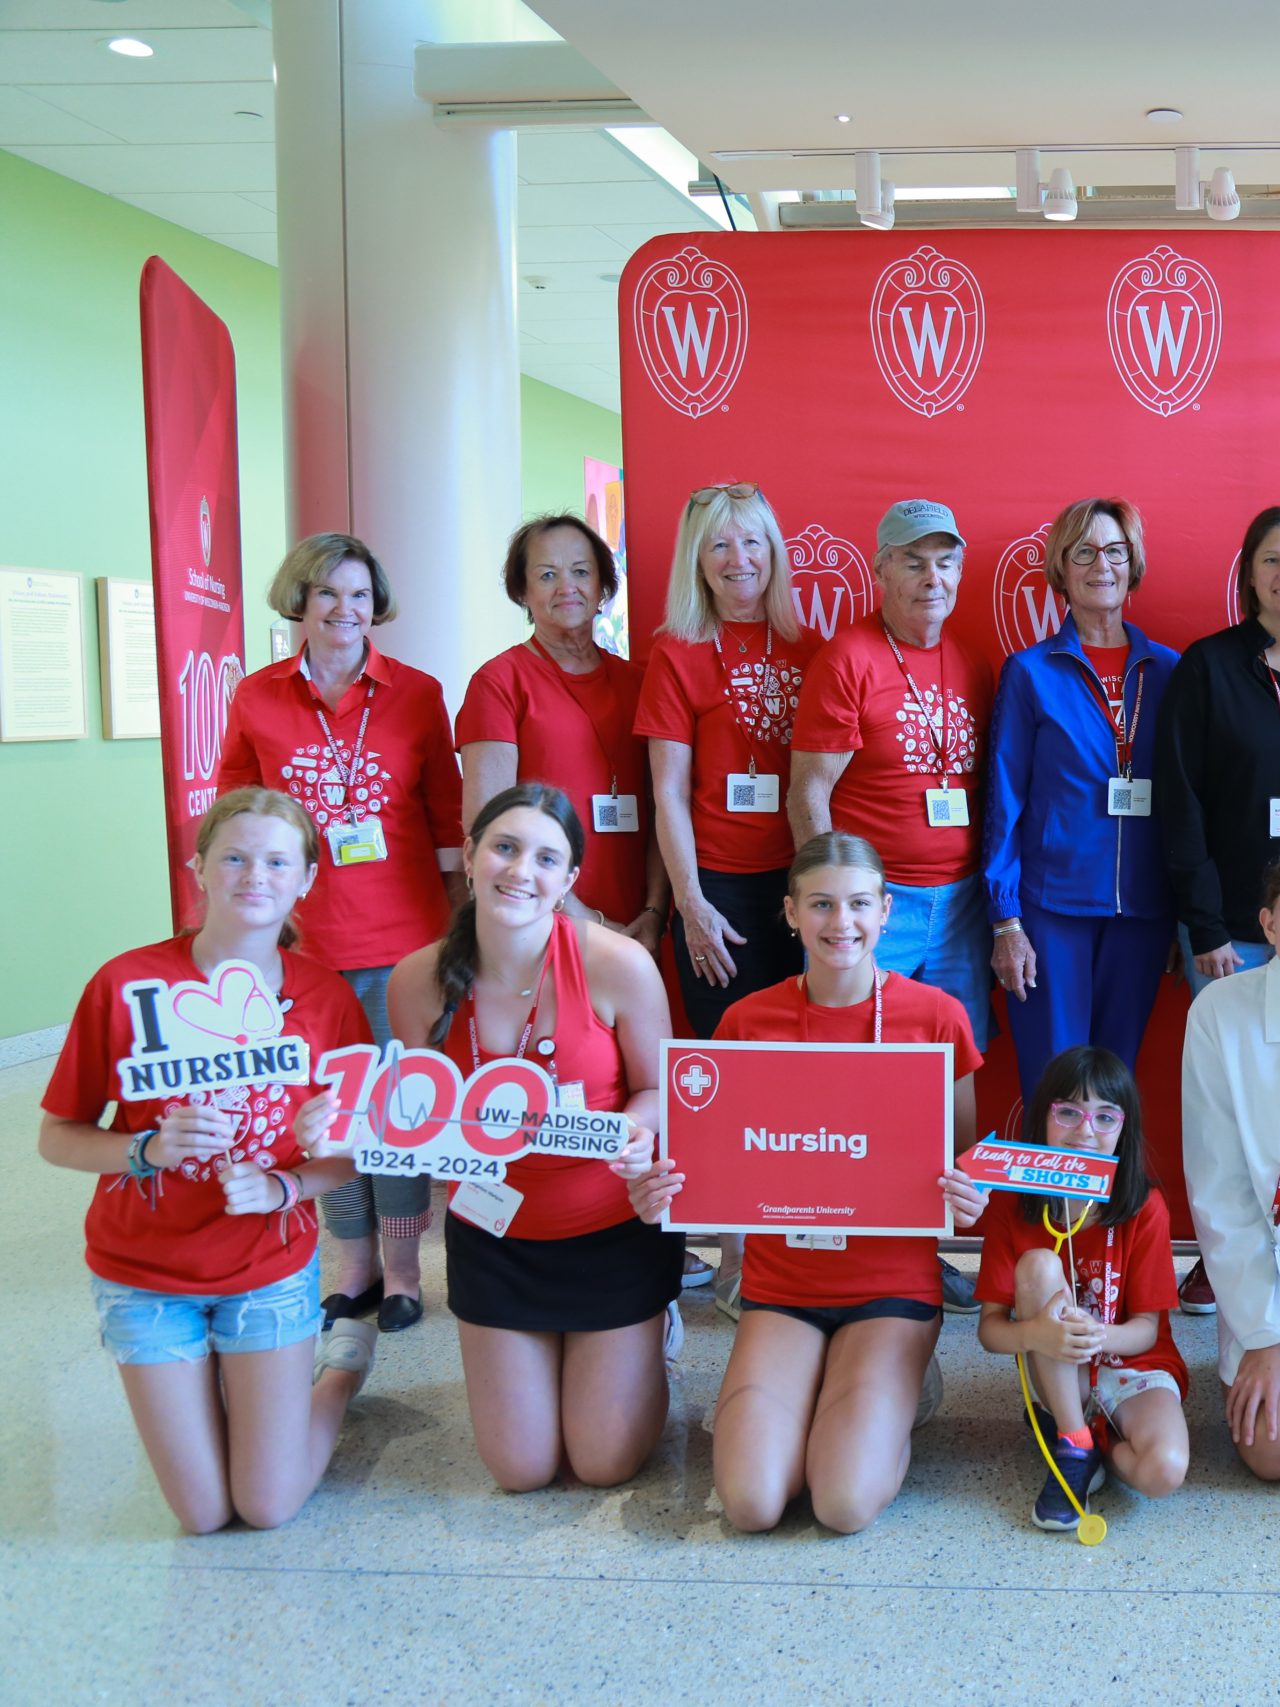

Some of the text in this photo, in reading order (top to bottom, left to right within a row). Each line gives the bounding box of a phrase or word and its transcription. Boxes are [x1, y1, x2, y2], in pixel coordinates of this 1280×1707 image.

[662, 302, 719, 378] W
[899, 302, 956, 377] W
[1136, 301, 1193, 376] W
[904, 505, 948, 517] DELAFIELD
[794, 581, 845, 641] W
[324, 785, 346, 806] W
[132, 987, 169, 1053] I
[128, 1043, 300, 1093] NURSING
[323, 1053, 549, 1157] 100
[475, 1107, 622, 1134] UW-MADISON
[523, 1132, 619, 1154] NURSING
[745, 1127, 868, 1159] Nursing
[360, 1150, 416, 1170] 1924
[438, 1157, 499, 1177] 2024
[972, 1147, 1087, 1171] Ready to Call the
[1022, 1168, 1090, 1188] SHOTS
[763, 1205, 855, 1216] Grandparents University
